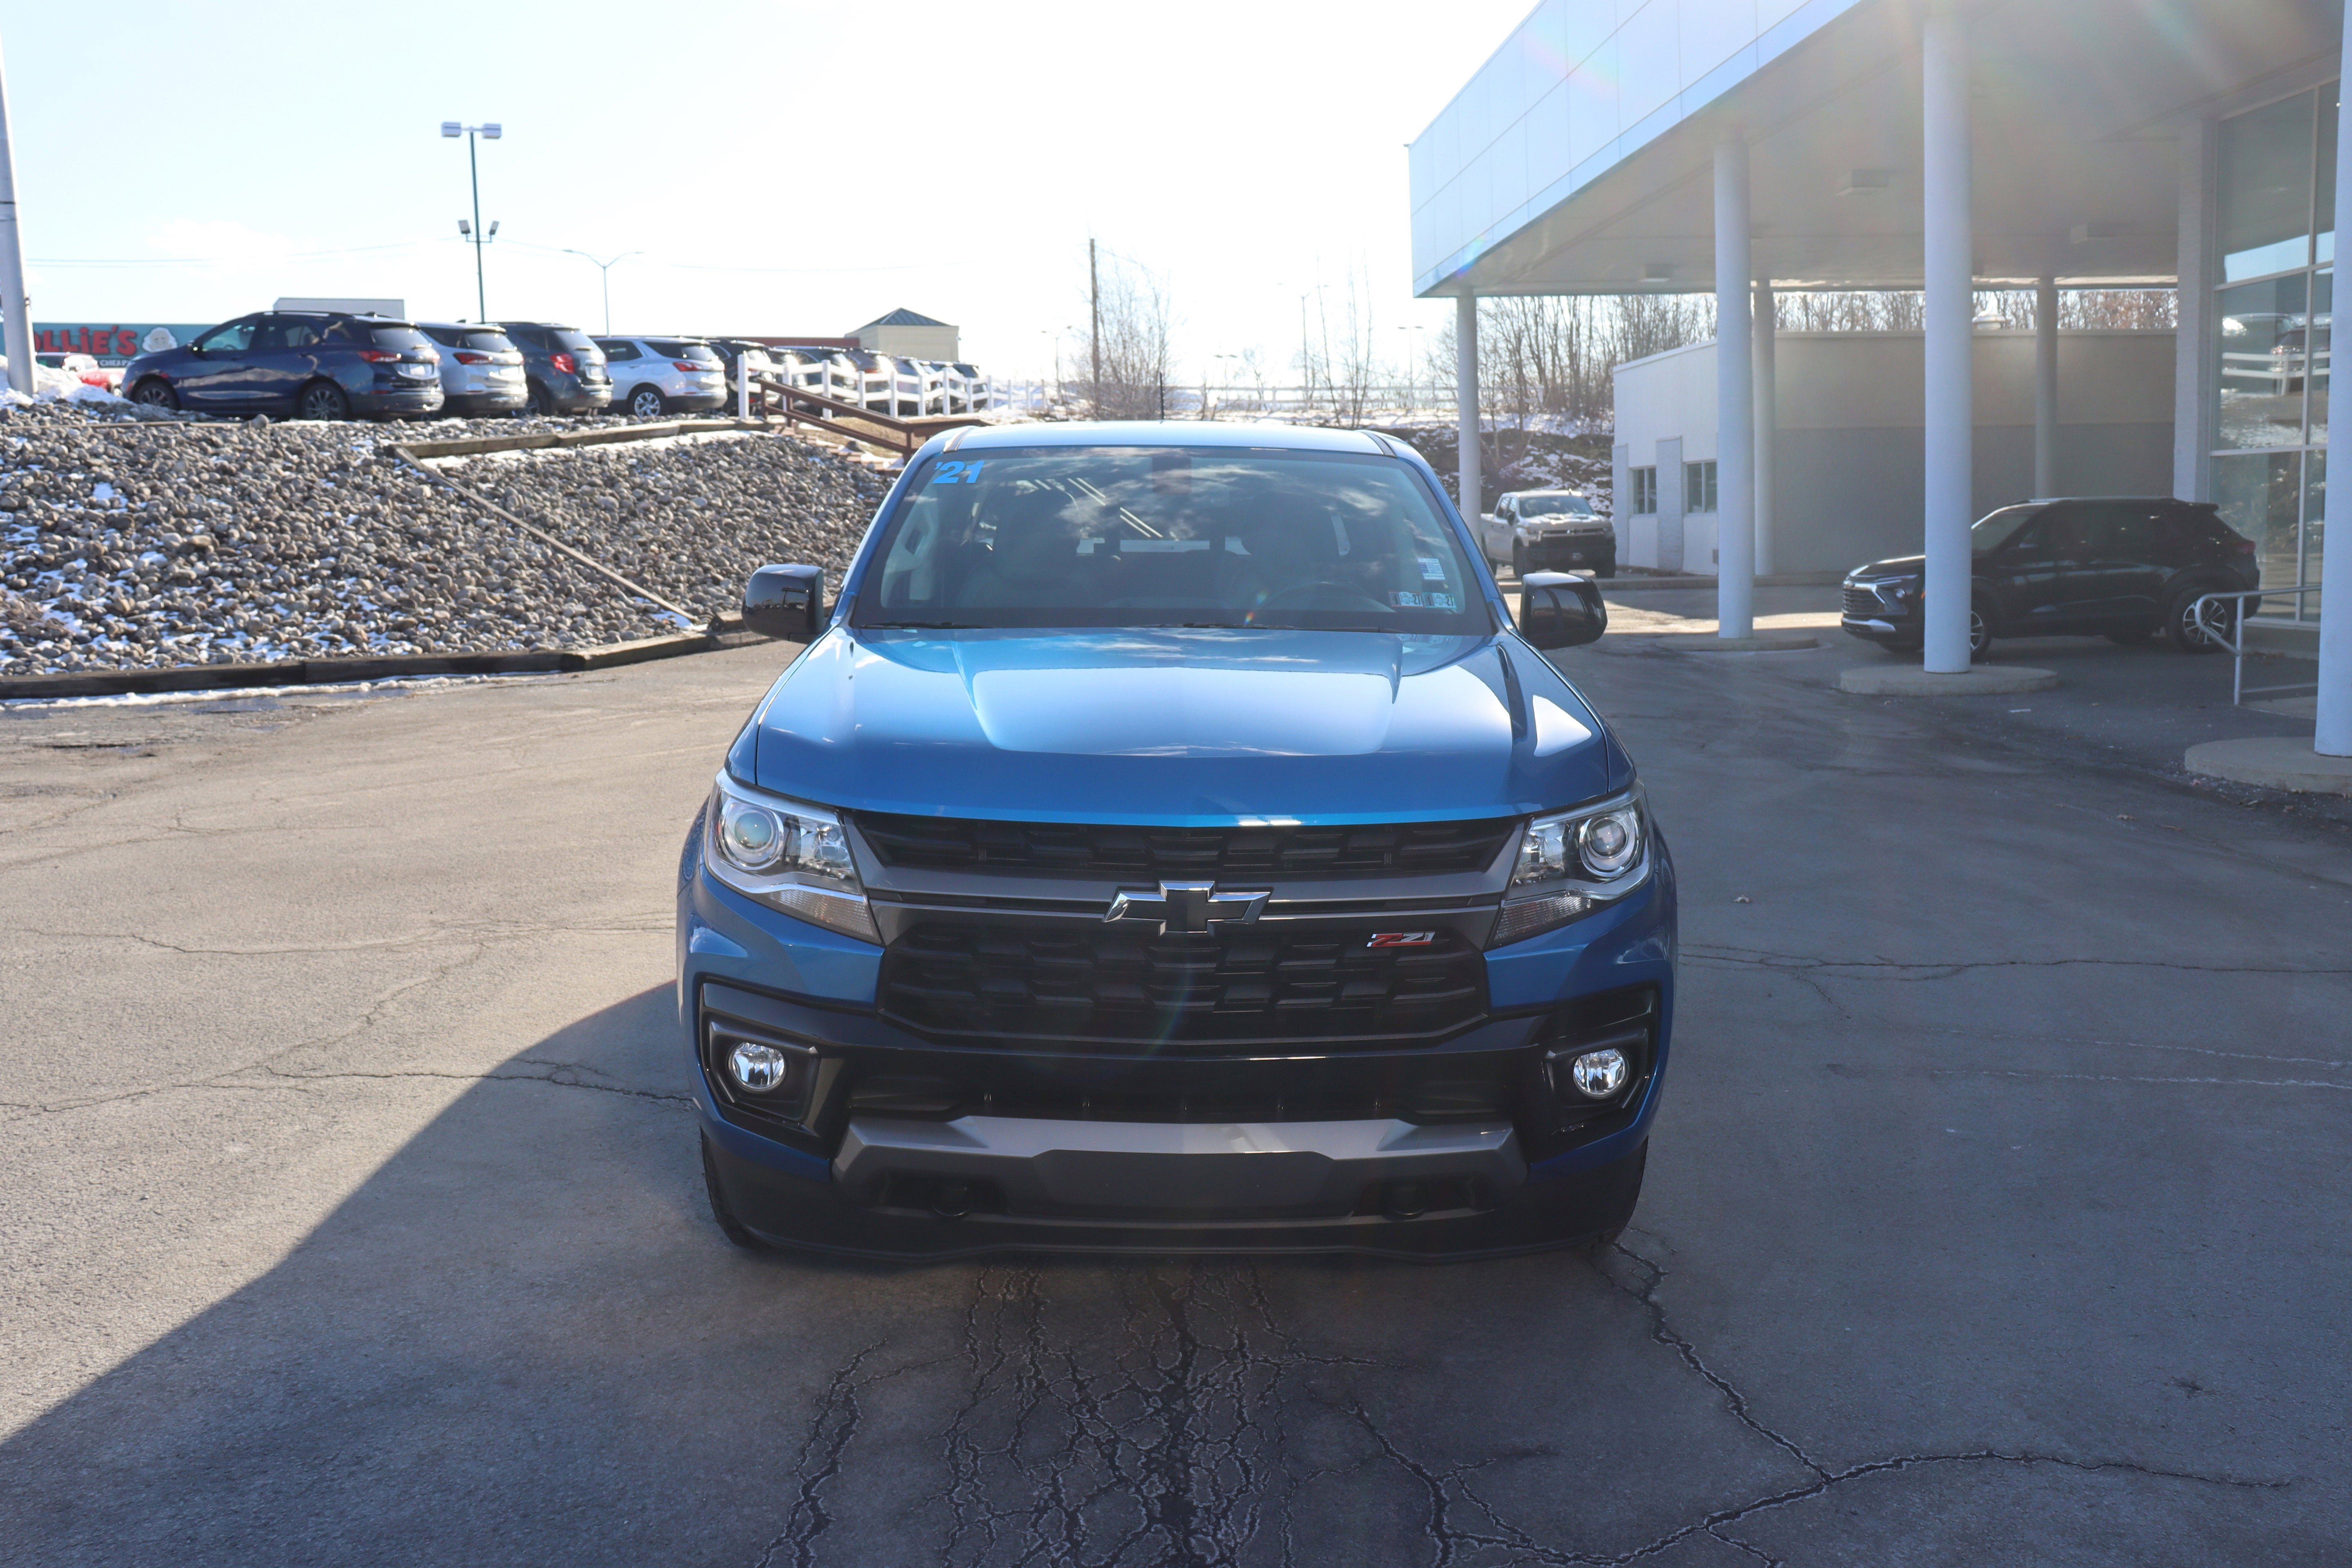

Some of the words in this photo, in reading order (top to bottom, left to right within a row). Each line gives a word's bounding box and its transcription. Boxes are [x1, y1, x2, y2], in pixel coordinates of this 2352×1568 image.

[933, 461, 985, 483] '21
[1412, 594, 1421, 605] 27
[1446, 595, 1454, 607] 27
[1367, 932, 1436, 947] Z71
